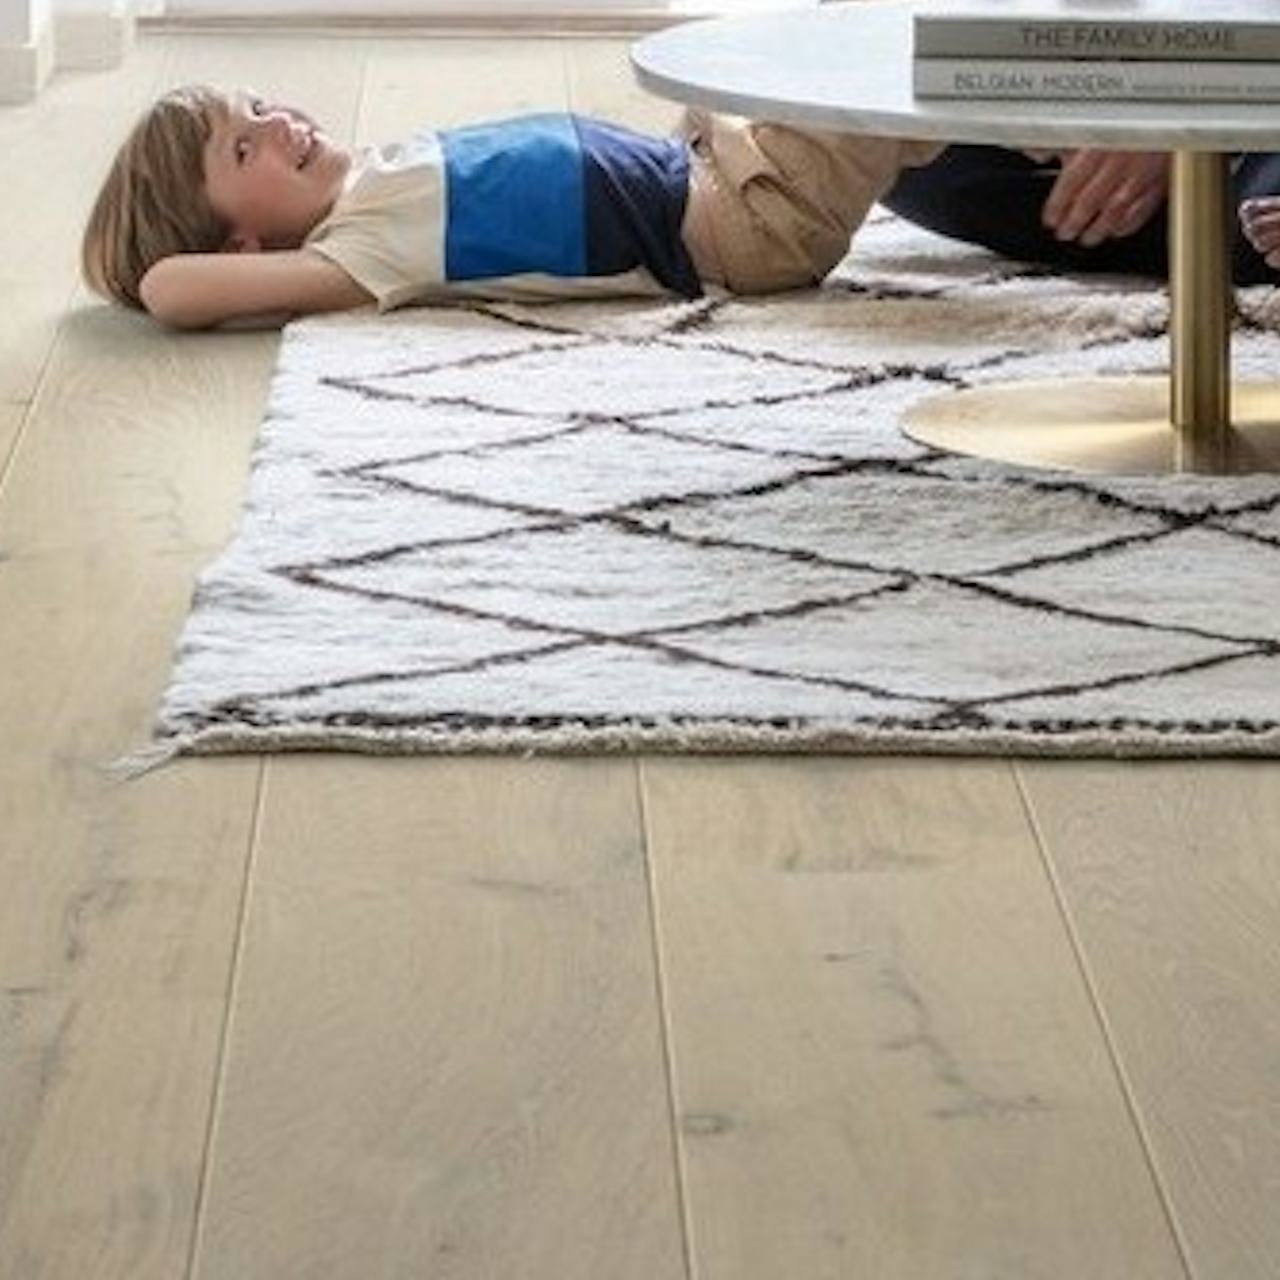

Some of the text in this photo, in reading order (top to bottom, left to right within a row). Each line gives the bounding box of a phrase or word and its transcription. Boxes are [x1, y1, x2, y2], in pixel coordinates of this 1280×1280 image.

[1020, 29, 1236, 52] THE FAMILY HOME
[954, 72, 1033, 91] BELGIAN
[1041, 75, 1124, 92] MODERN
